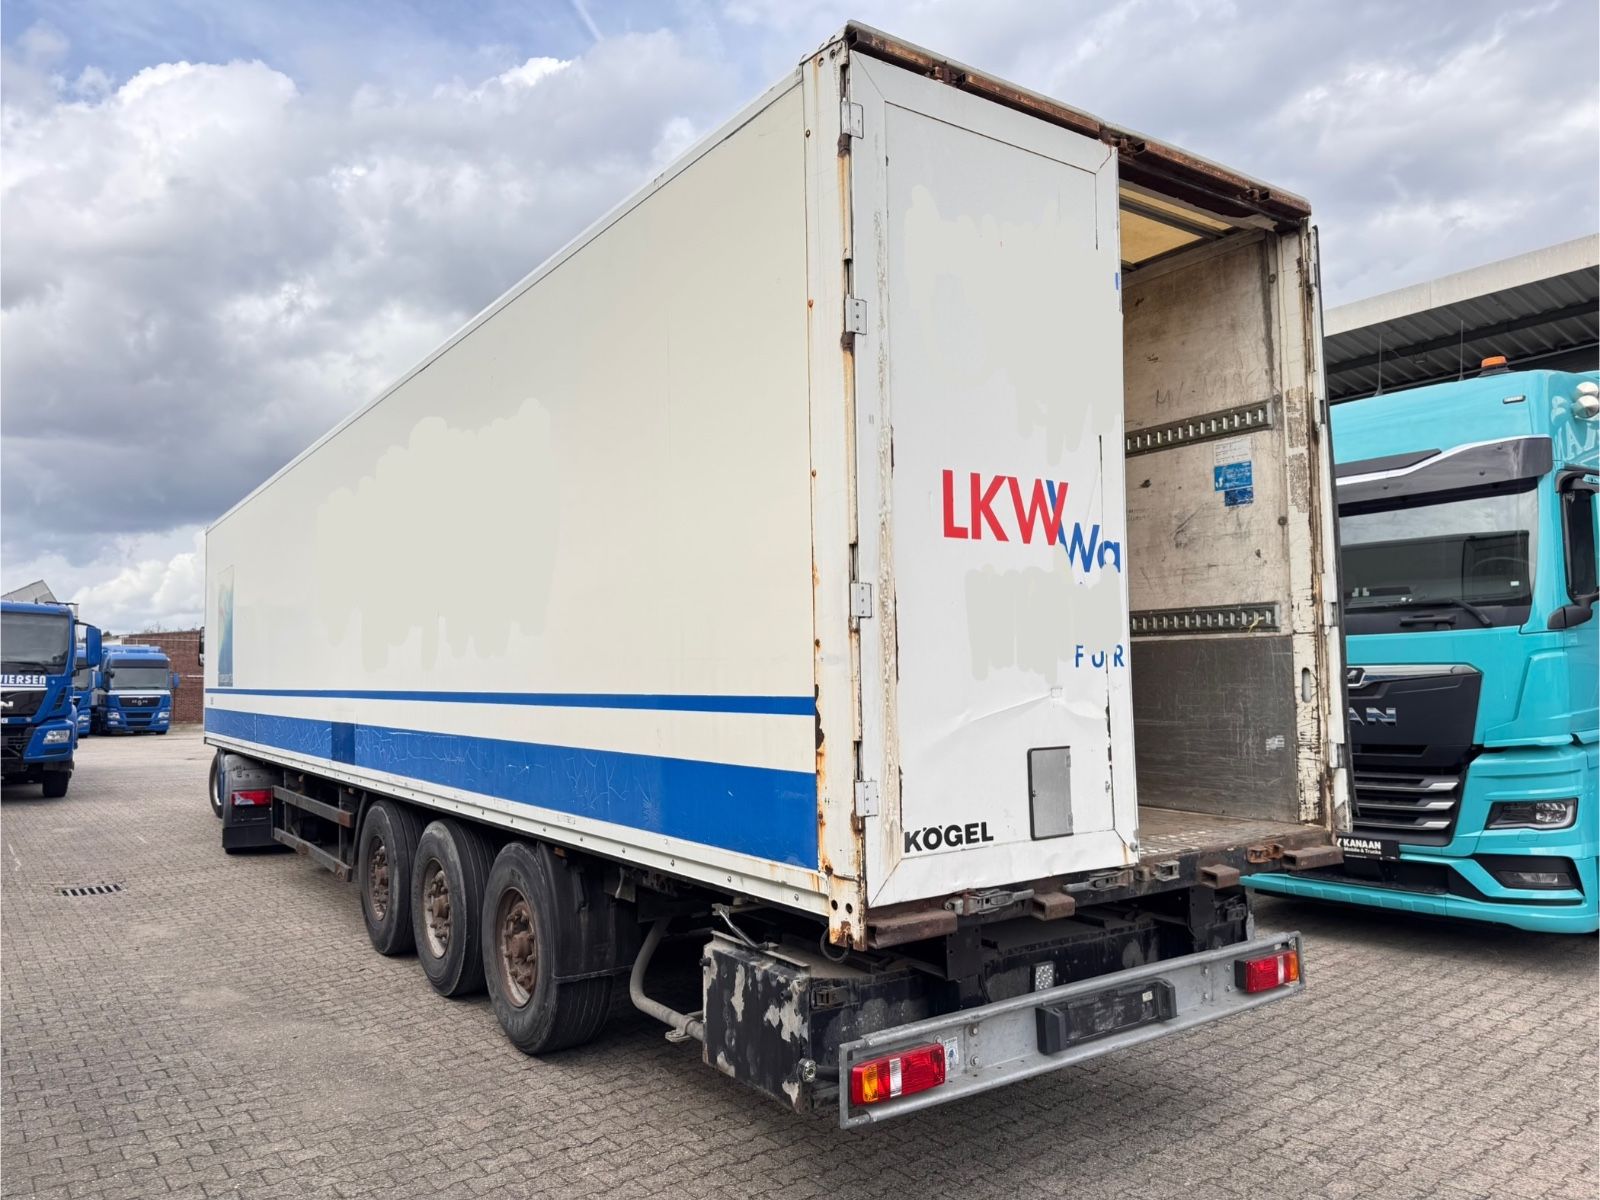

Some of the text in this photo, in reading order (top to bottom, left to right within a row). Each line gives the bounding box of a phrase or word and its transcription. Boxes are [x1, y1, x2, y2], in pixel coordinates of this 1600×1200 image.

[942, 469, 1069, 546] LKW
[904, 821, 995, 853] KÖGEL
[1343, 838, 1382, 850] KANAAN
